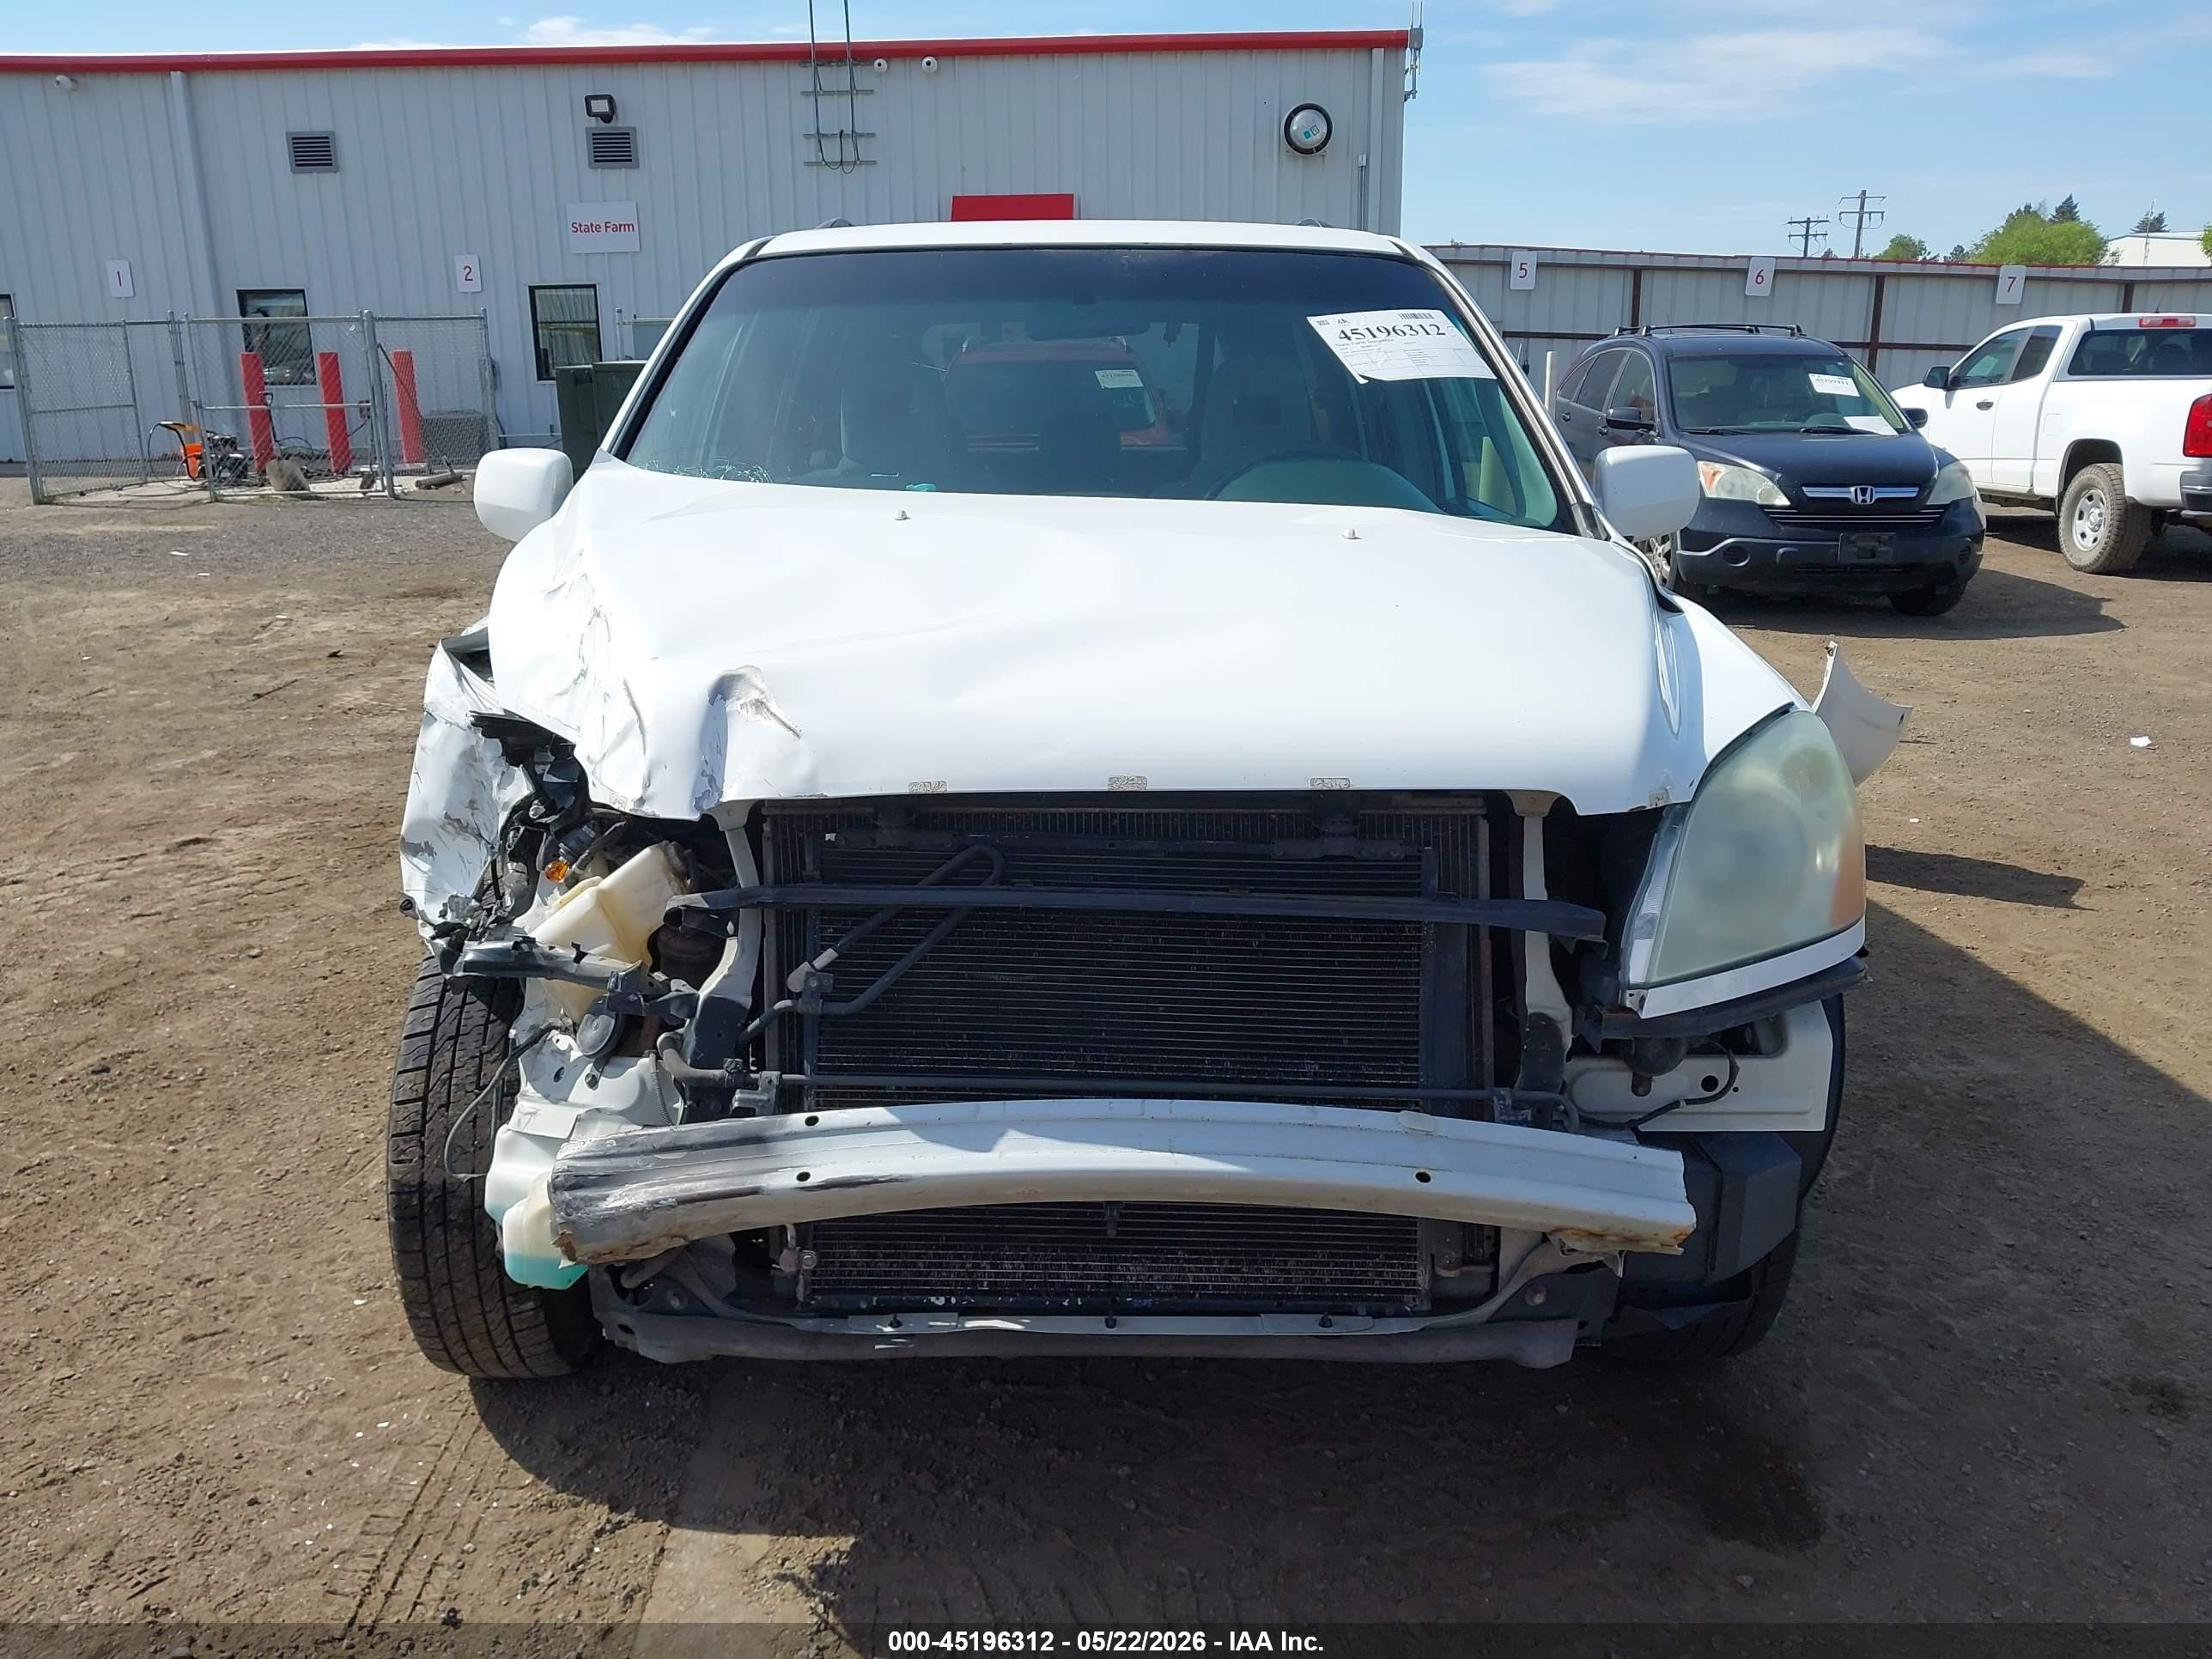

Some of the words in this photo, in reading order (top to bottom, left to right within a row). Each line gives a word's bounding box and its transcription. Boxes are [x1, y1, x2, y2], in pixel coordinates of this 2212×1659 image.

[571, 222, 601, 233] State
[605, 221, 635, 233] Farm
[116, 270, 122, 287] 1
[464, 265, 473, 282] 2
[1519, 262, 1528, 279] 5
[1755, 268, 1765, 285] 6
[2007, 276, 2017, 293] 7
[1338, 324, 1446, 341] 45196312
